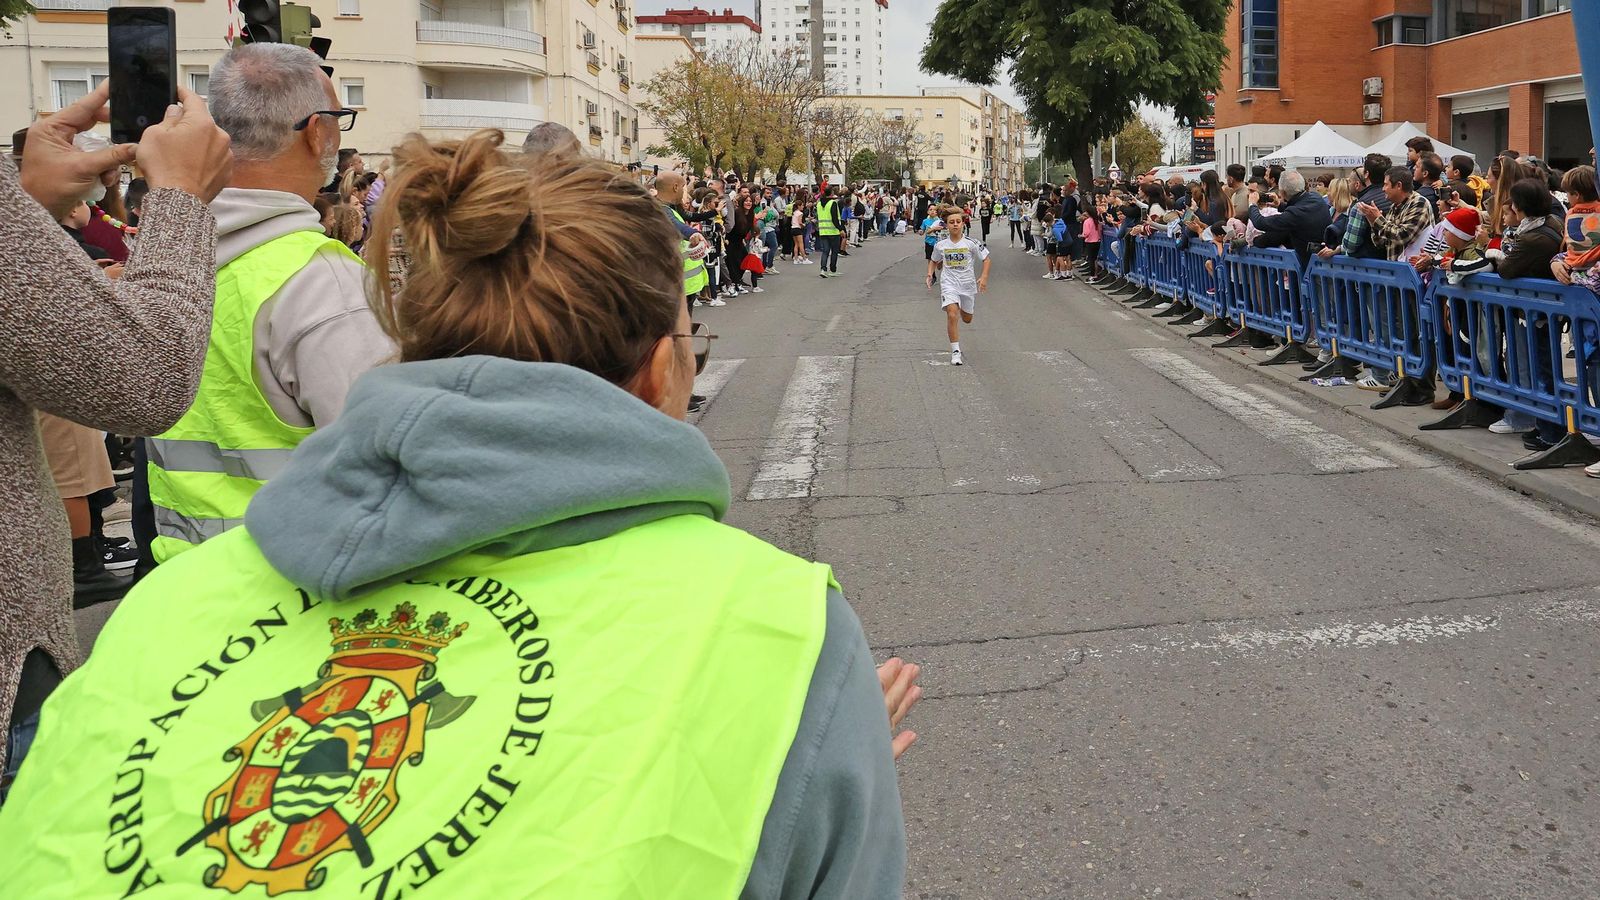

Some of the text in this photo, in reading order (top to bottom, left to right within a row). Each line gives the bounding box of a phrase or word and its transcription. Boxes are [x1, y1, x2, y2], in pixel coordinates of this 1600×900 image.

[402, 575, 555, 684] MBEROS
[500, 692, 554, 756] DE
[360, 763, 522, 900] JEREZ
